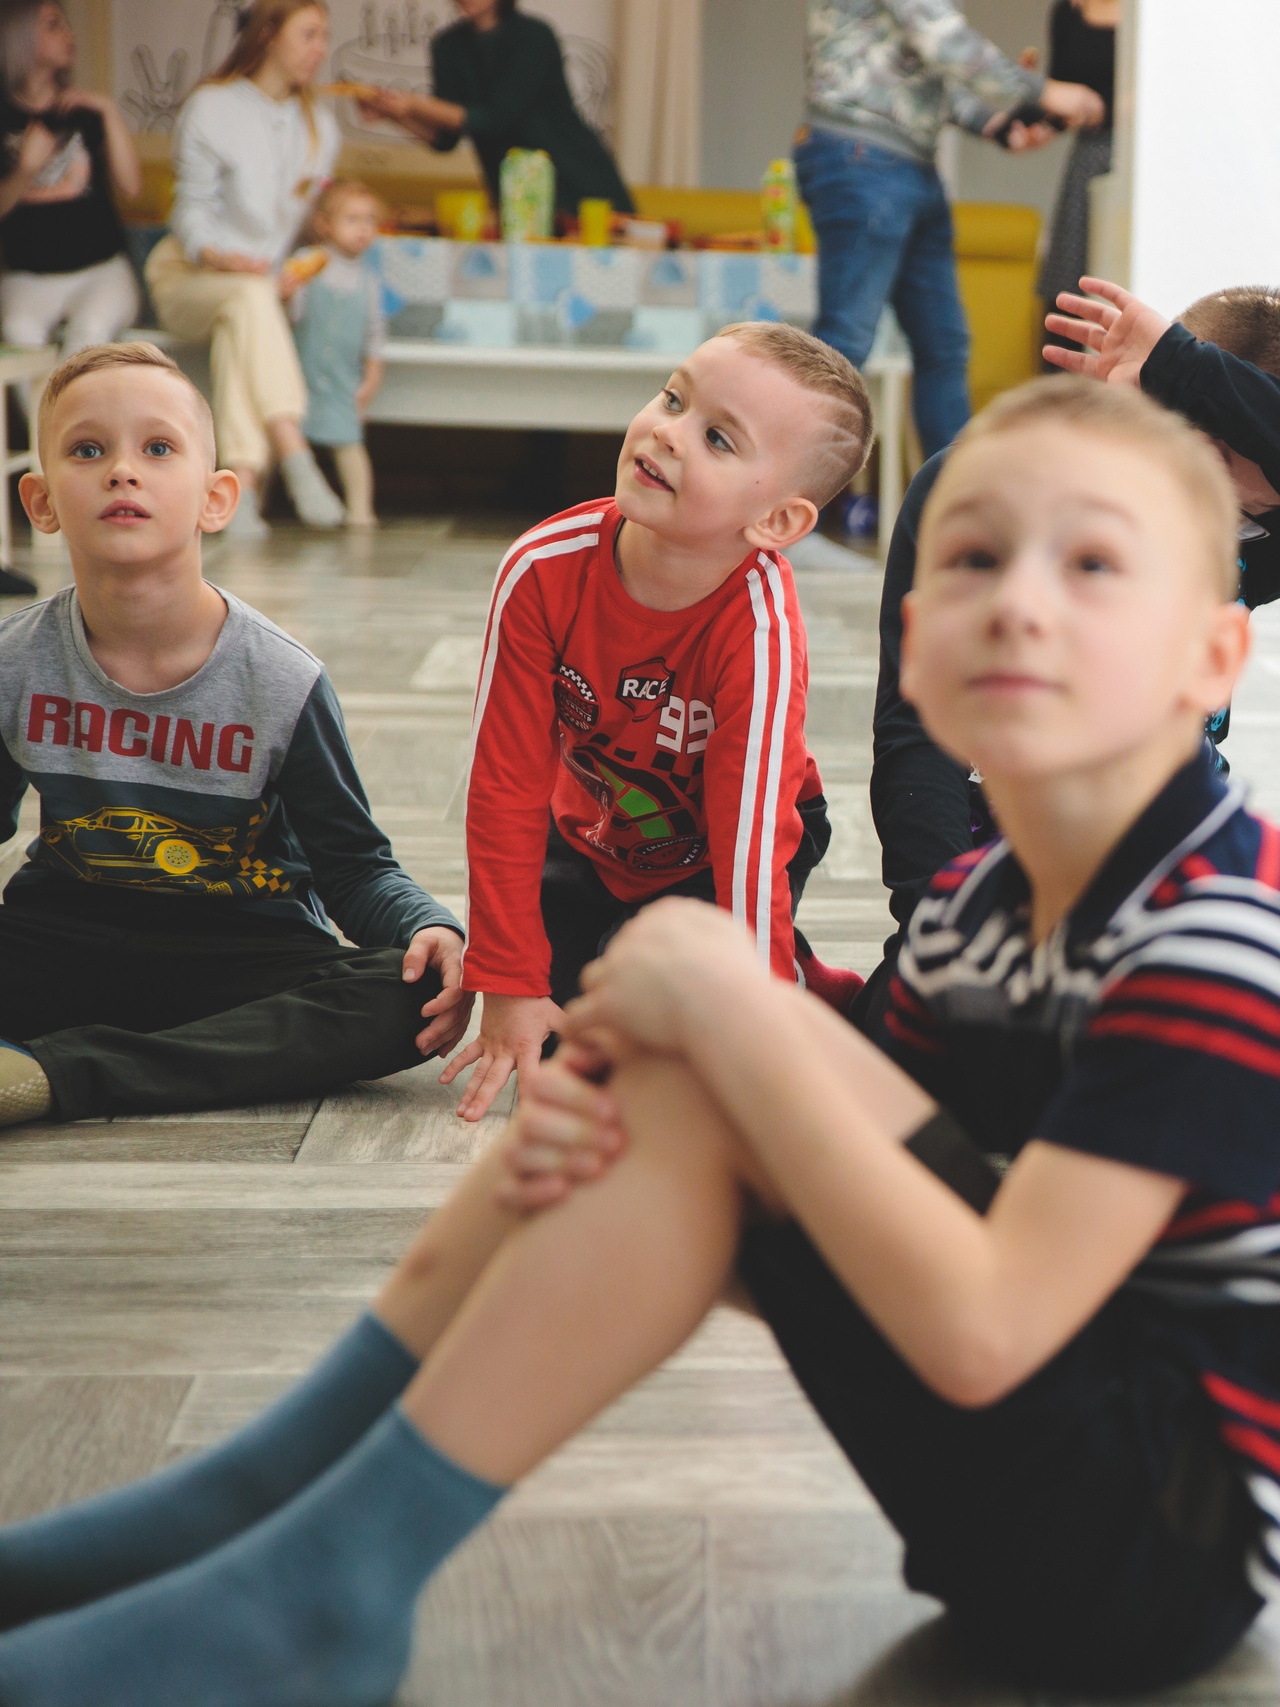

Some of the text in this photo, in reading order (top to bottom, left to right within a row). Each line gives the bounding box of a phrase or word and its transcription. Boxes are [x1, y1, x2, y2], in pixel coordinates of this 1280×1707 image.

[622, 676, 669, 700] RACE
[26, 693, 255, 774] RACING
[655, 695, 717, 754] 99
